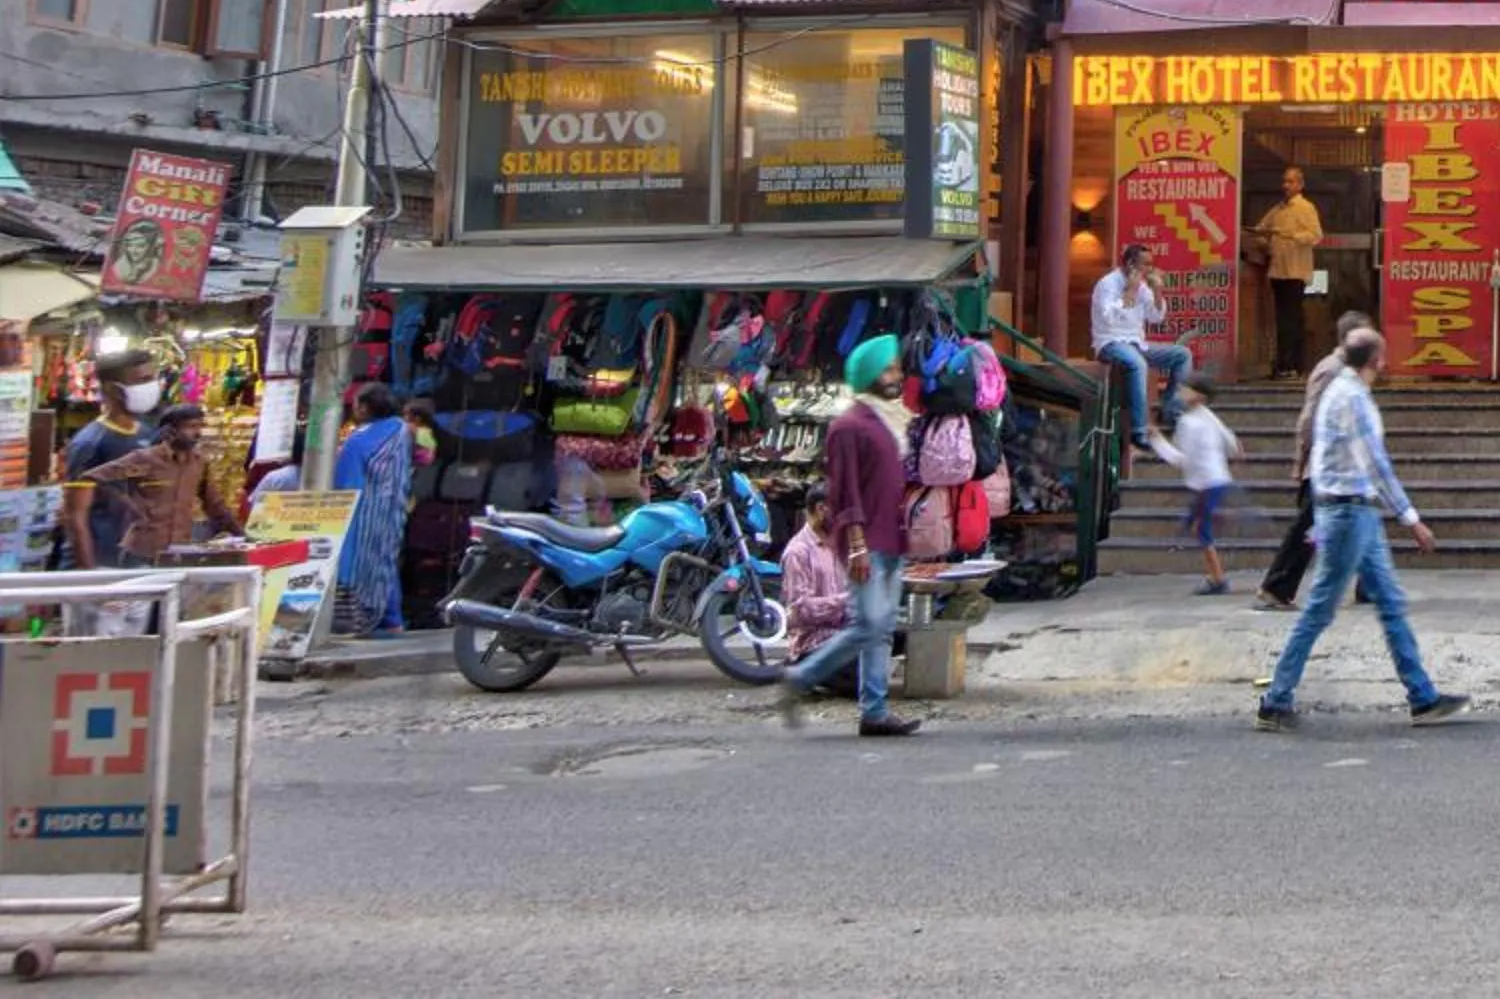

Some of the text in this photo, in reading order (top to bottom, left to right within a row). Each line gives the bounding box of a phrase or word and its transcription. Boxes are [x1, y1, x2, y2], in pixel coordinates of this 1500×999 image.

[1072, 55, 1155, 106] IBEX
[1167, 55, 1283, 104] HOTEL
[1396, 101, 1498, 122] HOTEL
[519, 109, 667, 145] VOLVO
[1138, 127, 1216, 157] IBEX
[137, 155, 225, 186] Manali
[501, 147, 683, 176] SEMI SLEEPER
[135, 177, 220, 206] Gift
[1126, 177, 1229, 200] RESTAURANT
[1402, 122, 1481, 251] IBEX
[125, 196, 215, 226] Corner
[1134, 225, 1157, 239] WE
[1390, 261, 1490, 281] RESTAURANT
[1403, 286, 1480, 366] SPA
[44, 813, 105, 831] HDFC
